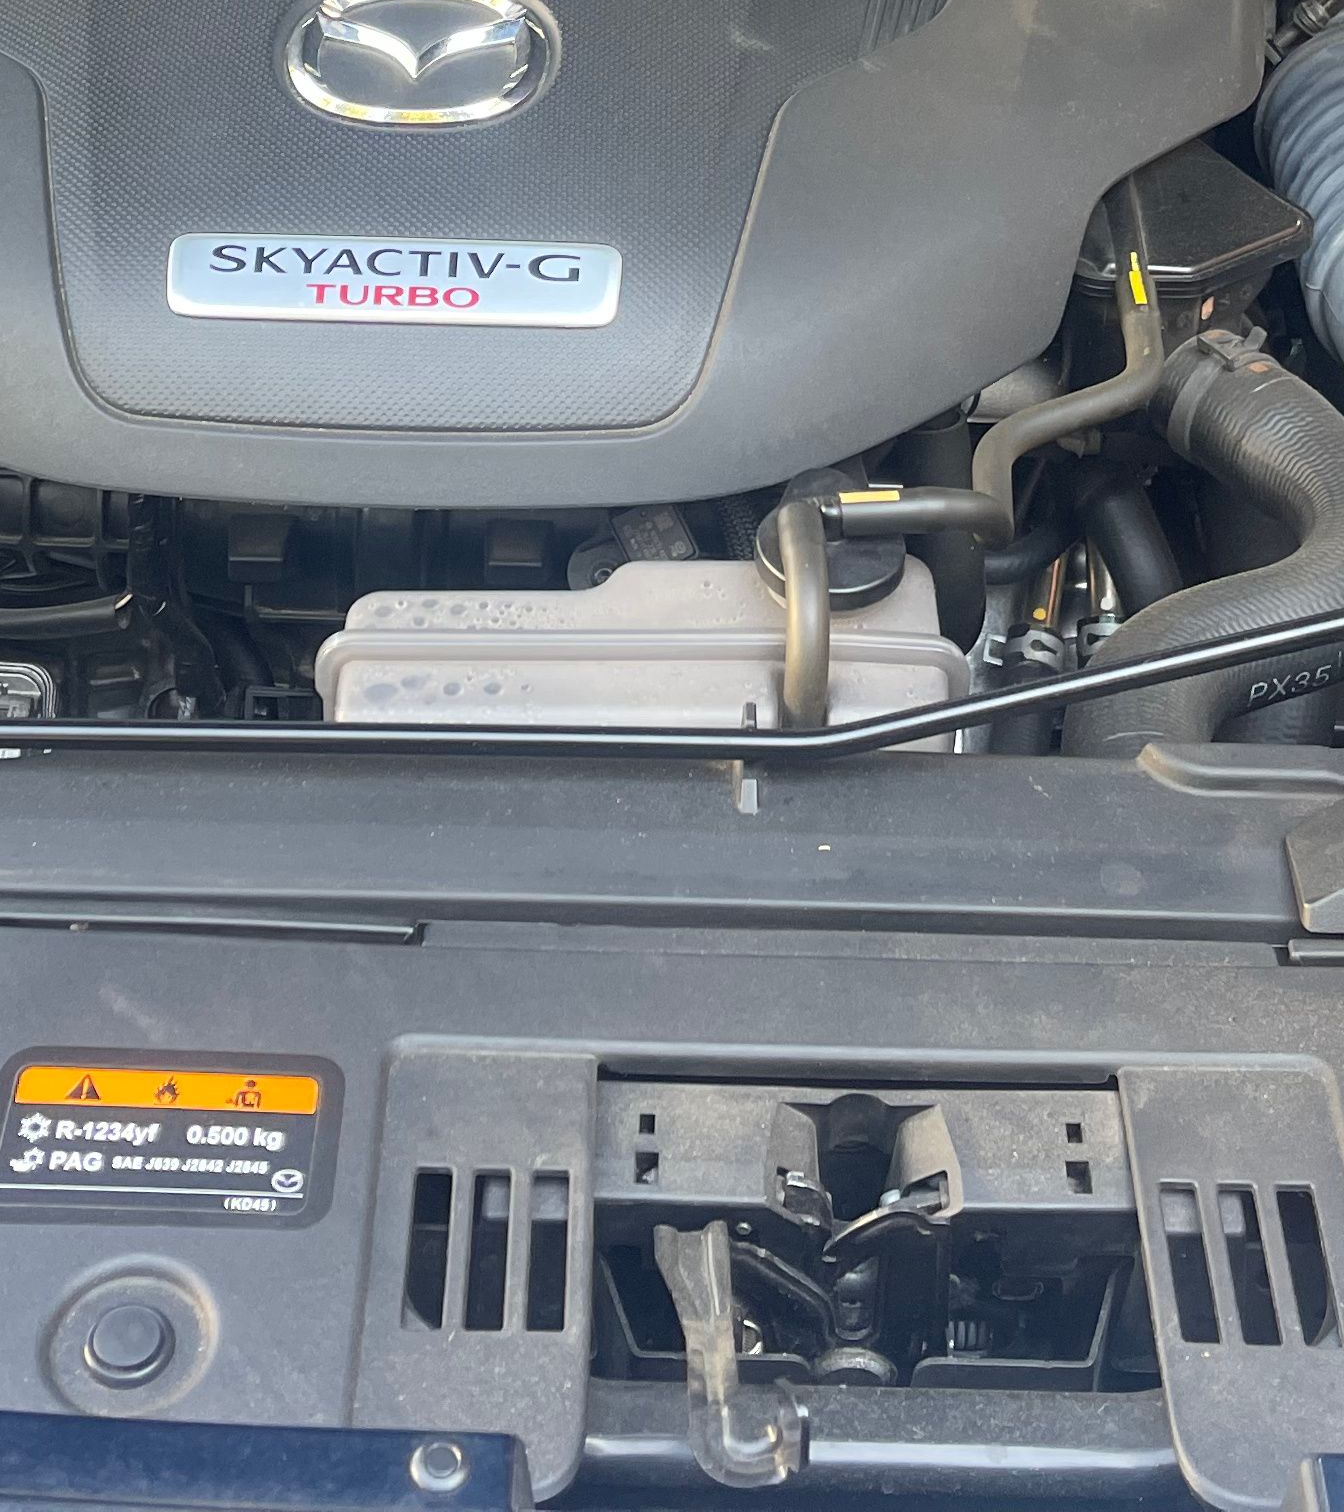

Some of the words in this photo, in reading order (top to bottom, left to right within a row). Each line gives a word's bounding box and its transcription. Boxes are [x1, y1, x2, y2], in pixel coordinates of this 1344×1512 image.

[209, 244, 580, 283] SKYACTIV-G
[306, 283, 481, 309] TURBO
[56, 1120, 161, 1147] R-1234yf
[186, 1124, 249, 1146] 0.500
[252, 1127, 286, 1152] kg
[49, 1150, 103, 1172] PAG
[111, 1155, 143, 1170] SAE
